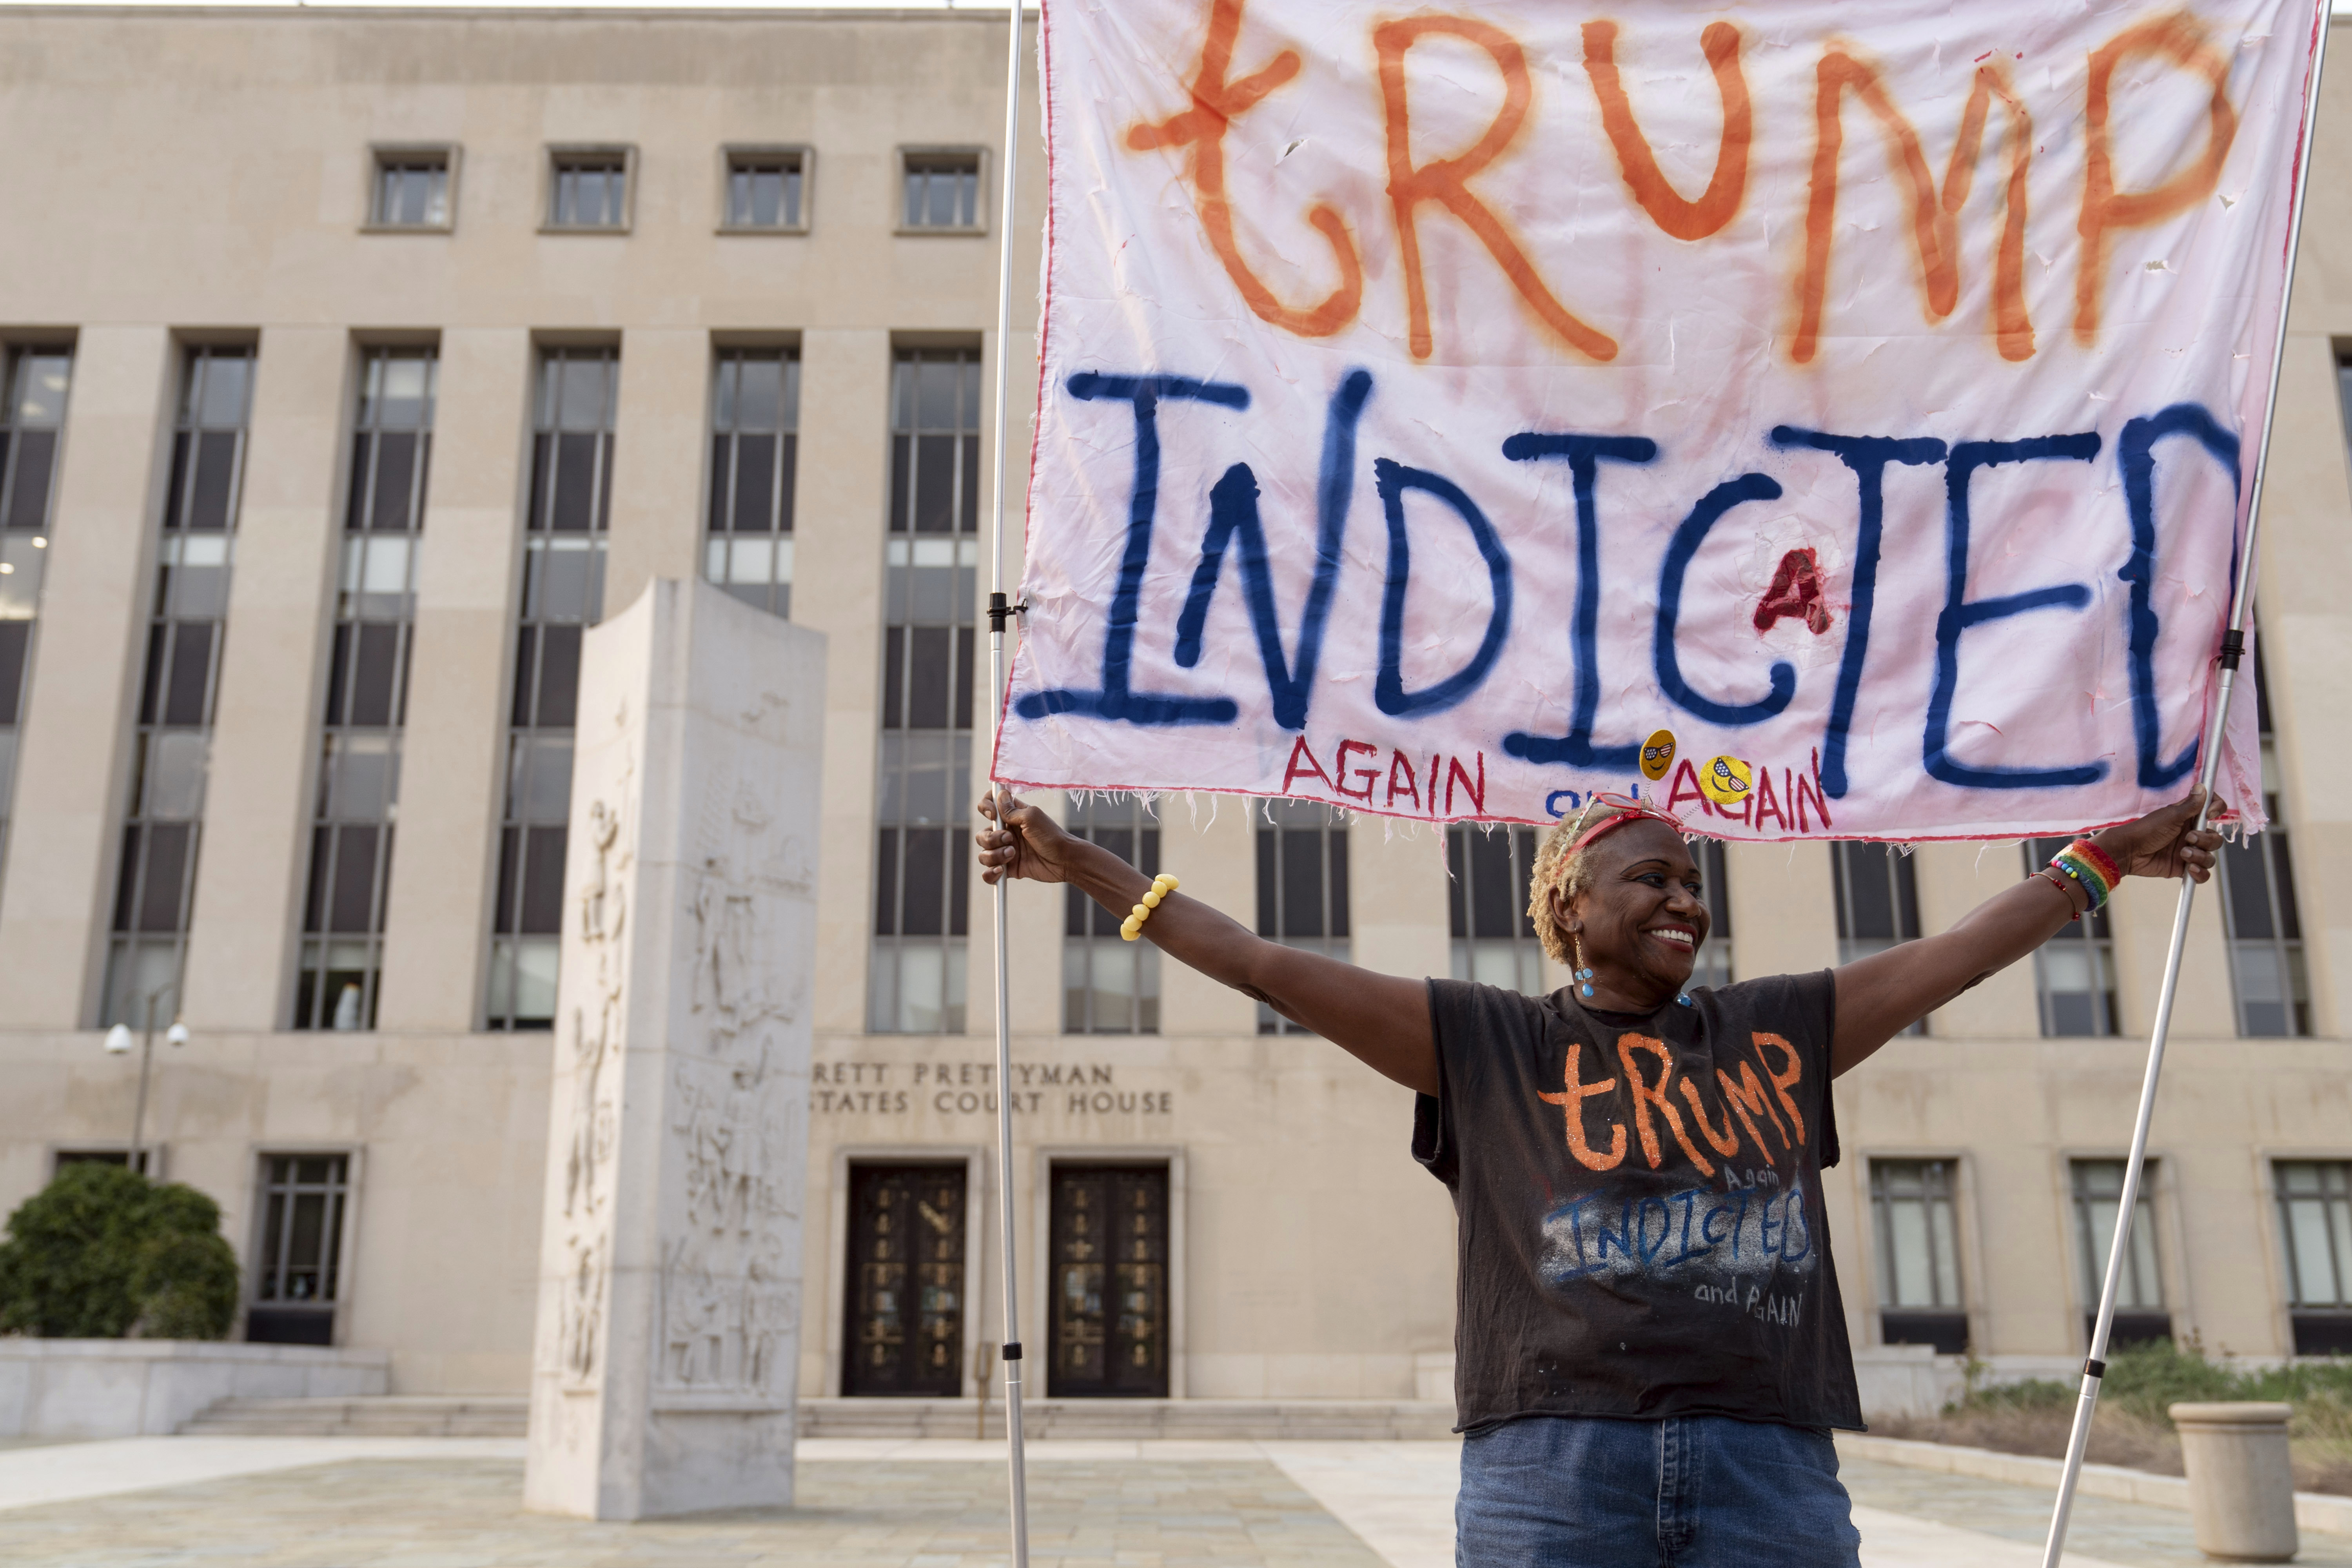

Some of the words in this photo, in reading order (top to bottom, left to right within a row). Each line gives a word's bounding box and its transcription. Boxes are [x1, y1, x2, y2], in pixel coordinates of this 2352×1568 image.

[1015, 368, 2243, 802] INDICTED
[1282, 735, 1484, 815] AGAIN
[809, 1090, 909, 1114] TATES
[934, 1091, 1044, 1114] COURT
[1068, 1091, 1173, 1114] HOUSE
[913, 1062, 1114, 1086] PRETYMAN
[1548, 1185, 1810, 1281] INDICTED
[1694, 1276, 1738, 1306] and
[1745, 1284, 1802, 1328] AGAIN
